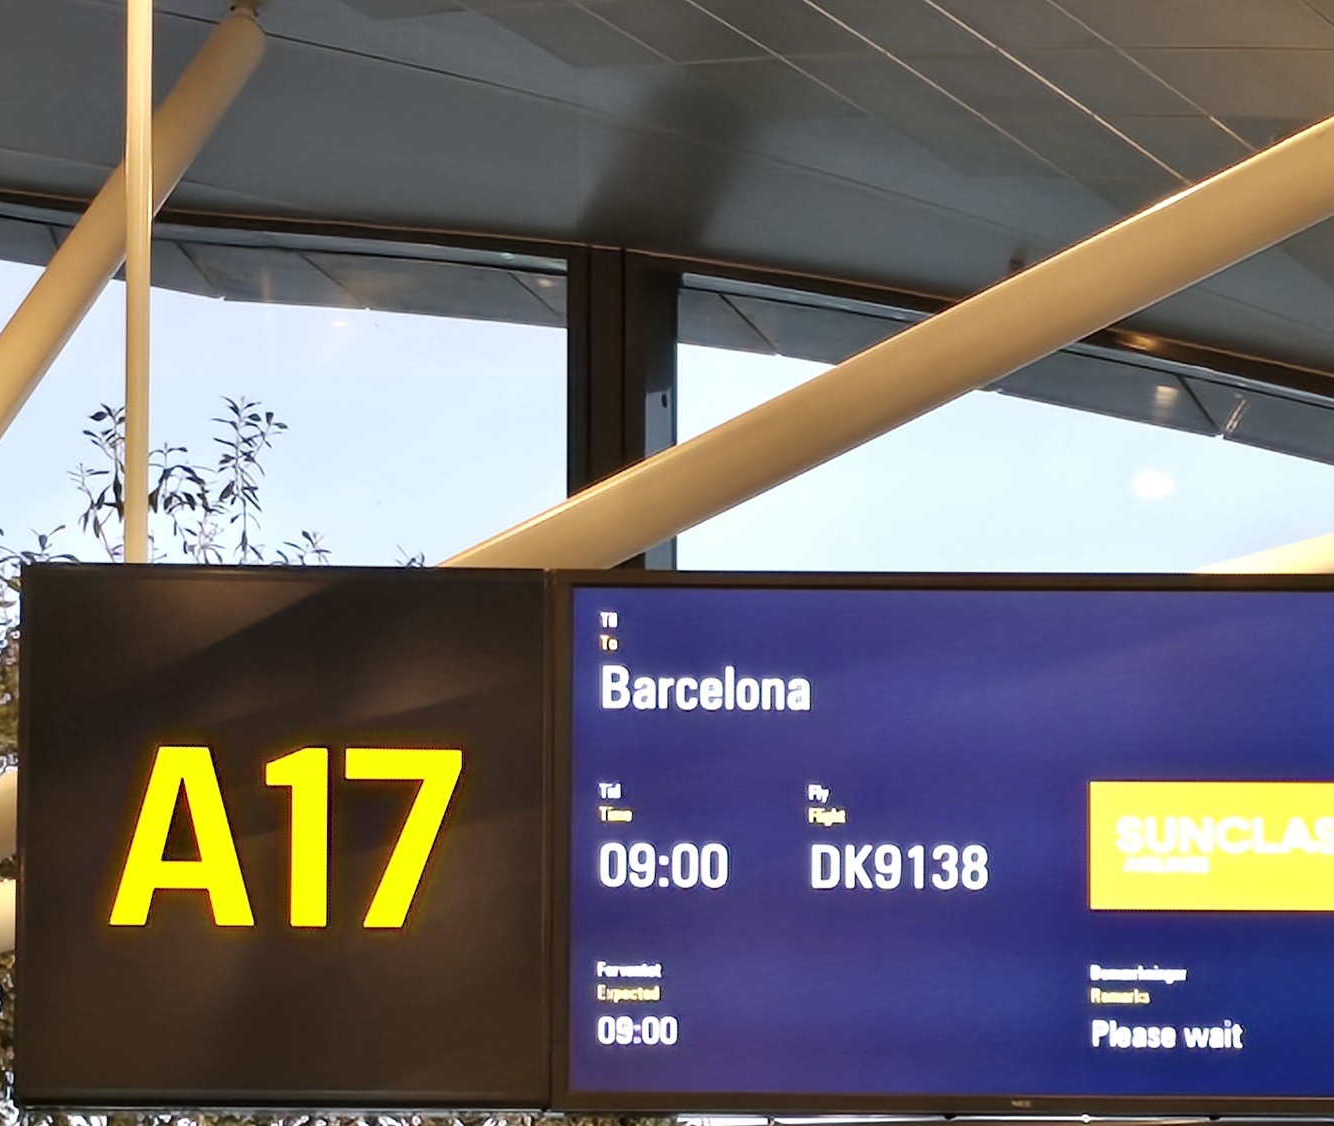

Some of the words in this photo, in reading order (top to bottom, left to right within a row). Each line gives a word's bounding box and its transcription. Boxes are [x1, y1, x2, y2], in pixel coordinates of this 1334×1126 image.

[599, 634, 618, 650] To
[601, 664, 811, 711] Barcelona
[598, 805, 633, 822] Time
[808, 807, 846, 827] Flight
[109, 746, 463, 928] A17
[599, 842, 729, 889] 09:00
[810, 843, 989, 891] DK9138
[596, 984, 661, 1004] Expected
[1090, 987, 1151, 1004] Remarks
[597, 1015, 678, 1045] 09:00
[1091, 1019, 1177, 1049] Please
[1184, 1019, 1244, 1049] wait
